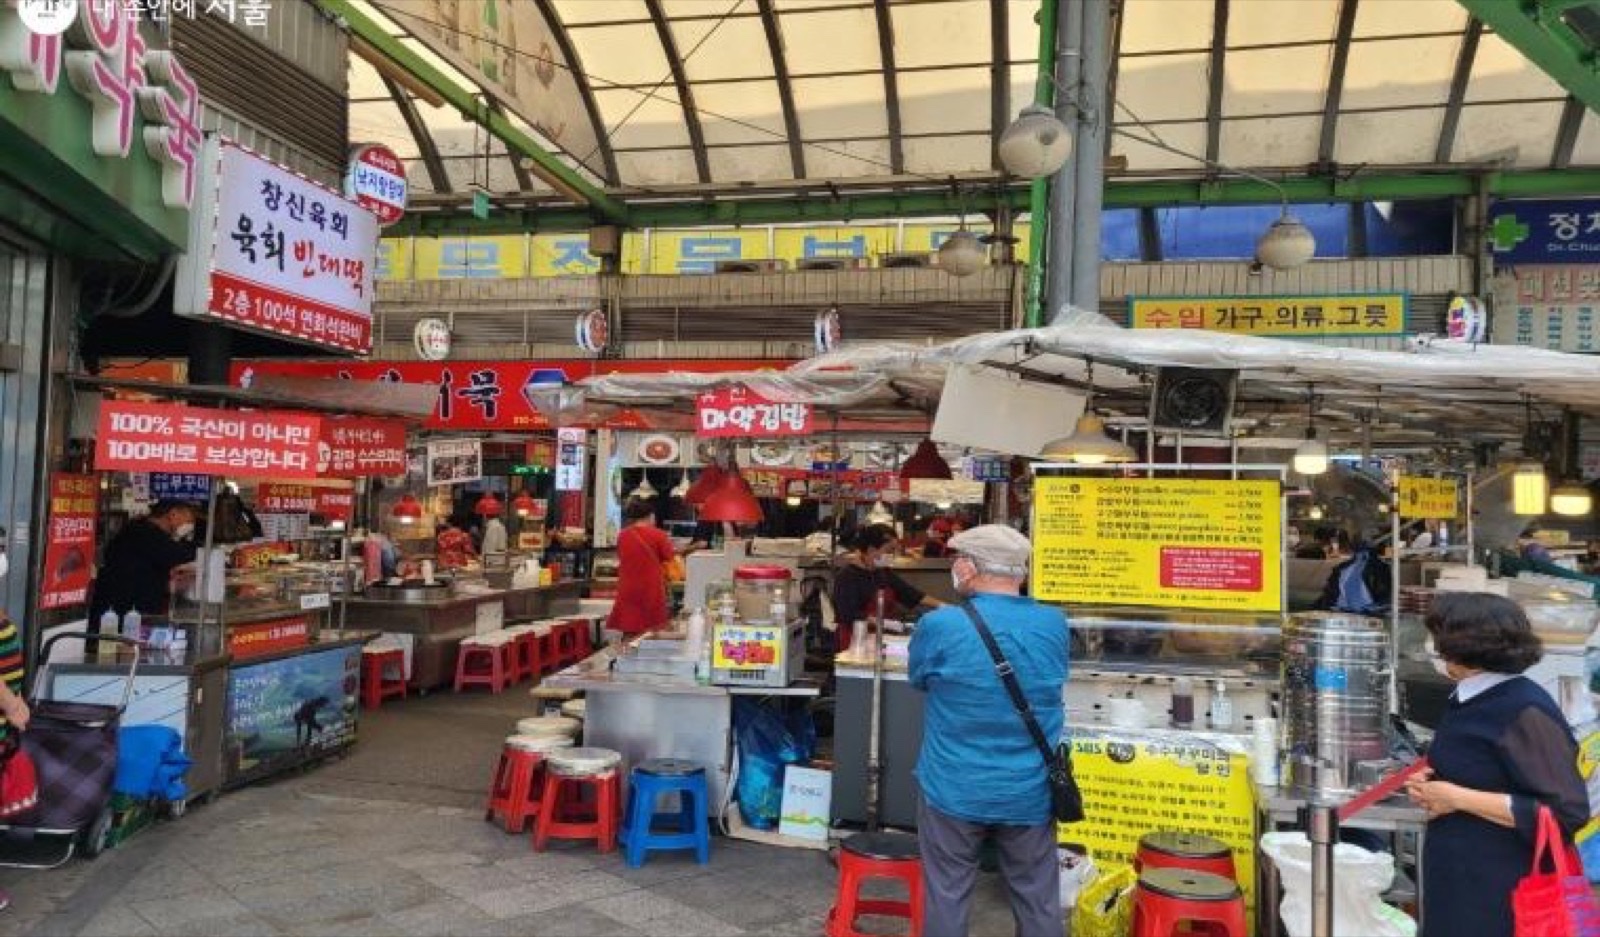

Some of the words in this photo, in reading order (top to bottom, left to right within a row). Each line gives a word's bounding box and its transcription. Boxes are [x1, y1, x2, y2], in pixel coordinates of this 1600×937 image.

[260, 178, 349, 240] 창신육회
[230, 213, 285, 272] 육회
[292, 239, 365, 298] 빈대떡
[222, 287, 251, 318] 2층
[254, 296, 297, 328] 100석
[1144, 308, 1205, 330] 수입
[109, 411, 174, 436] 100%
[180, 416, 246, 441] 국산이
[252, 423, 312, 446] 아니면
[701, 403, 809, 433] 마약김밥
[107, 440, 198, 463] 100배로
[204, 446, 307, 472] 보상합니다
